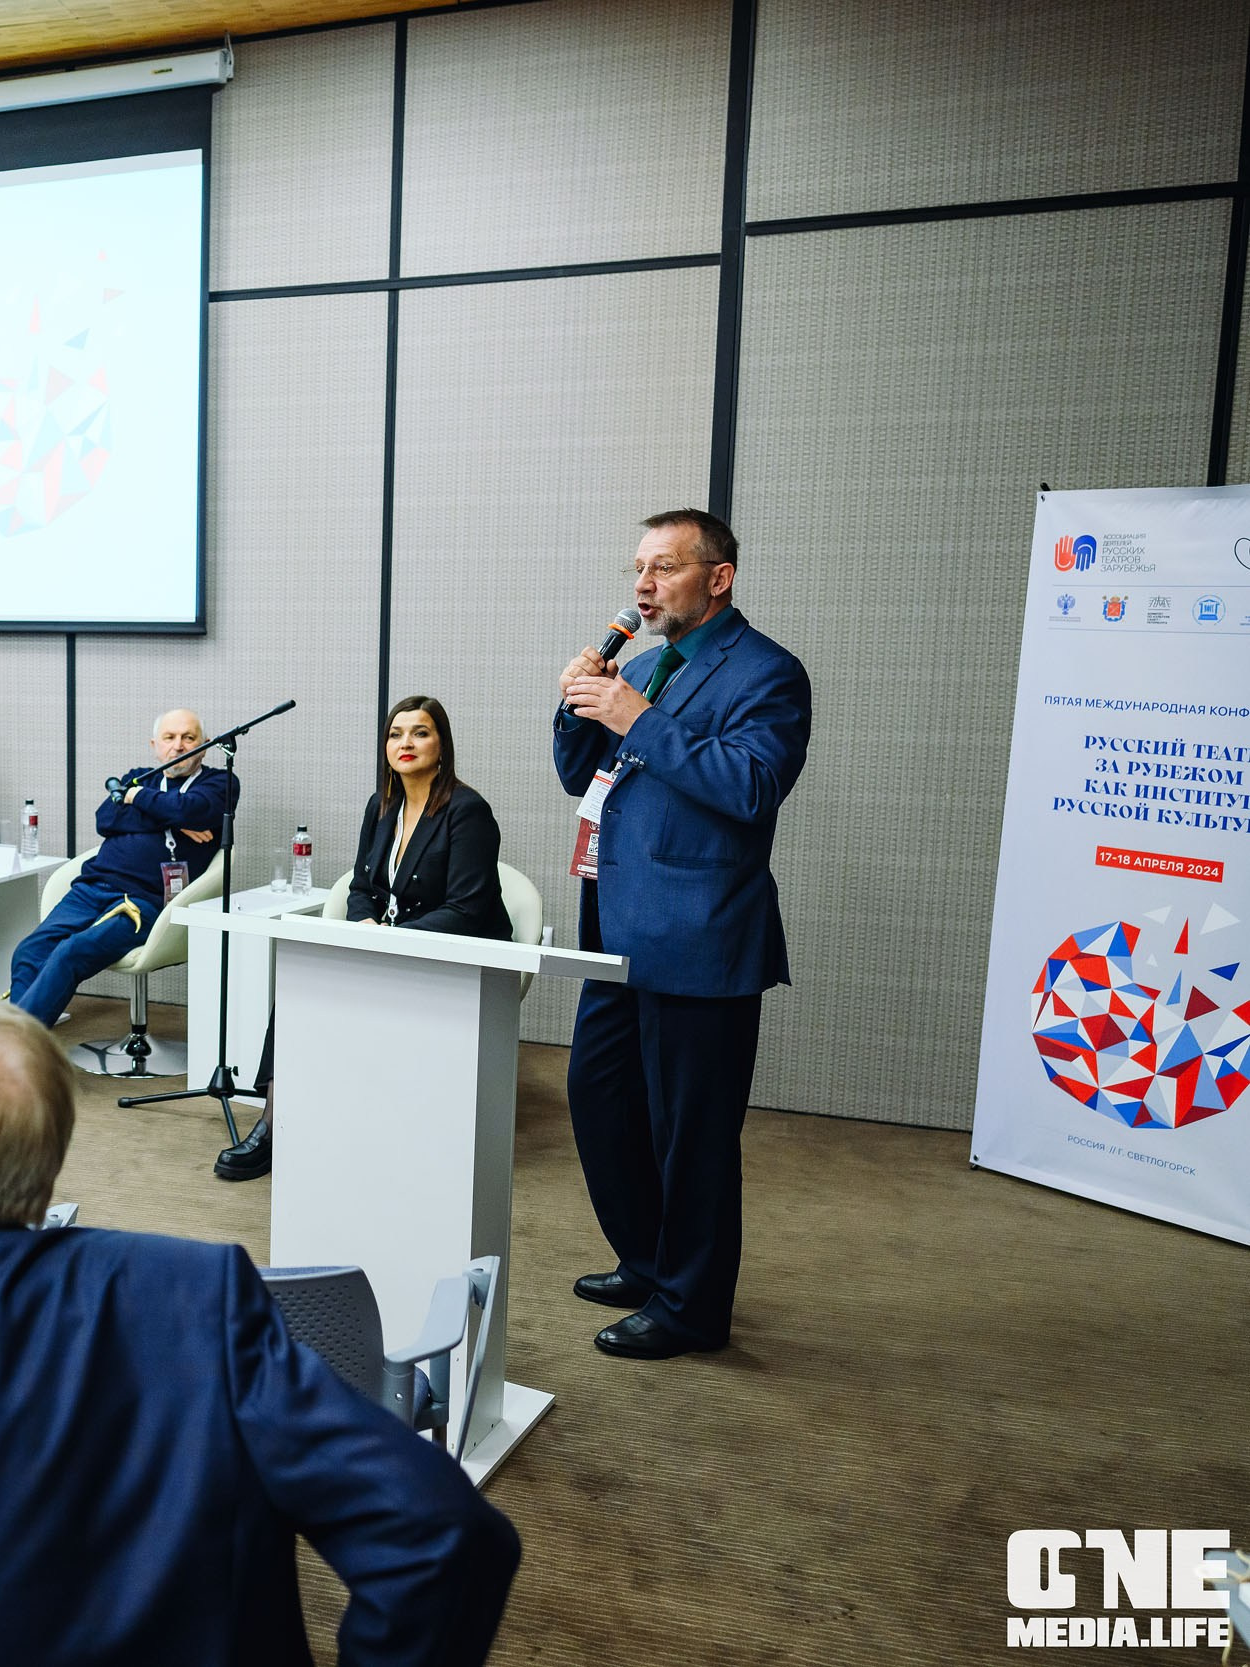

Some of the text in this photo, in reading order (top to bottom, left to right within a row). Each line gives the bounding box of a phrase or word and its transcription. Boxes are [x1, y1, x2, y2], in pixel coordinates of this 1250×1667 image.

[1101, 555, 1141, 564] ТЕАТРОВ
[1102, 547, 1145, 555] РУССКИХ
[1100, 563, 1156, 573] ЗАРУБЕЖЬЯ
[1044, 695, 1082, 708] ПЯТАЯ
[1085, 698, 1206, 715] МЕЖДУНАРОДНАЯ
[1084, 735, 1187, 758] РУССКИЙ
[1095, 758, 1244, 786] ЗА РУБЕЖОМ
[1084, 778, 1250, 810] КАК ИНСТИТУТ
[1052, 797, 1151, 822] РУССКОЙ
[1099, 852, 1219, 877] 17-18 АПРЕЛЯ 2024
[1067, 1135, 1105, 1151] РОССИЯ
[1127, 1151, 1196, 1176] СВЕТЛОГОРСК
